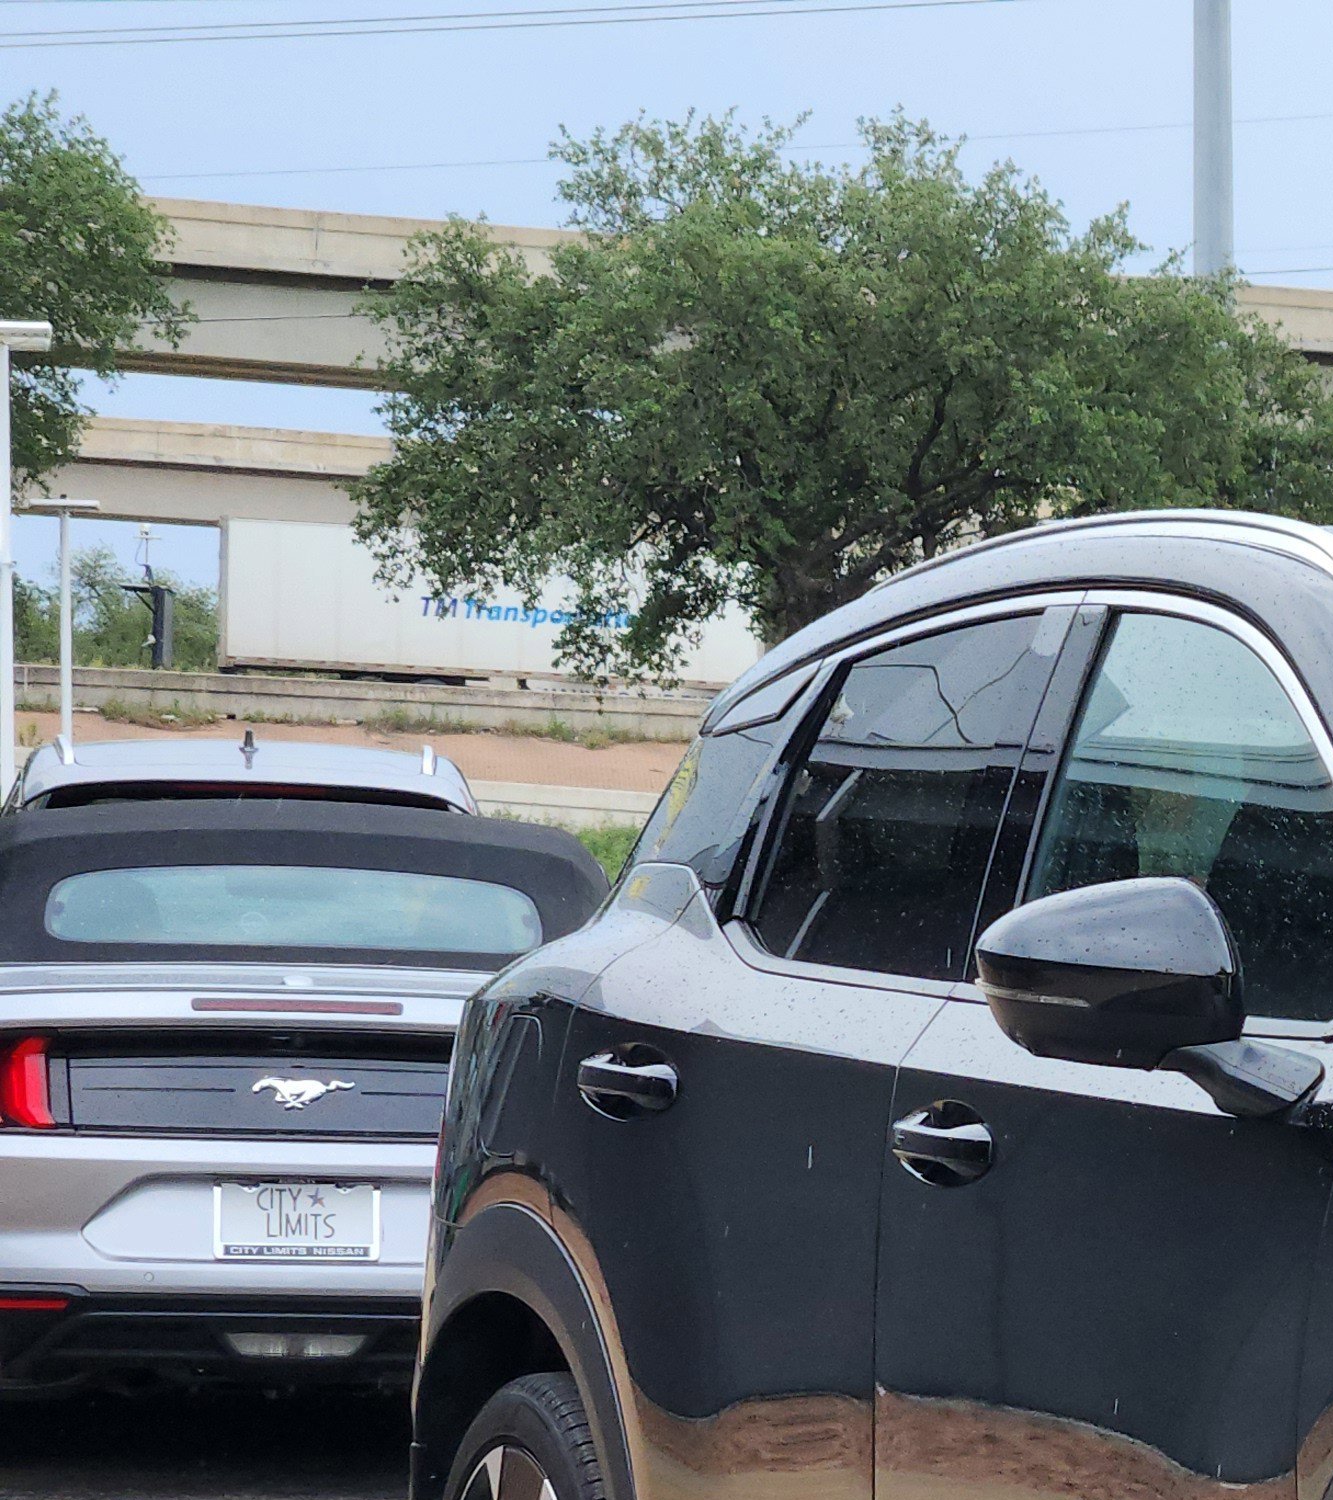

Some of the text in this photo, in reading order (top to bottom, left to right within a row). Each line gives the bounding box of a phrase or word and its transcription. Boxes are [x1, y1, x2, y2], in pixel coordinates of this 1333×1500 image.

[421, 596, 457, 618] TM
[256, 1187, 302, 1213] CITY
[266, 1213, 336, 1240] LIMITS
[229, 1246, 364, 1256] CITY LIMITS NISSAN
